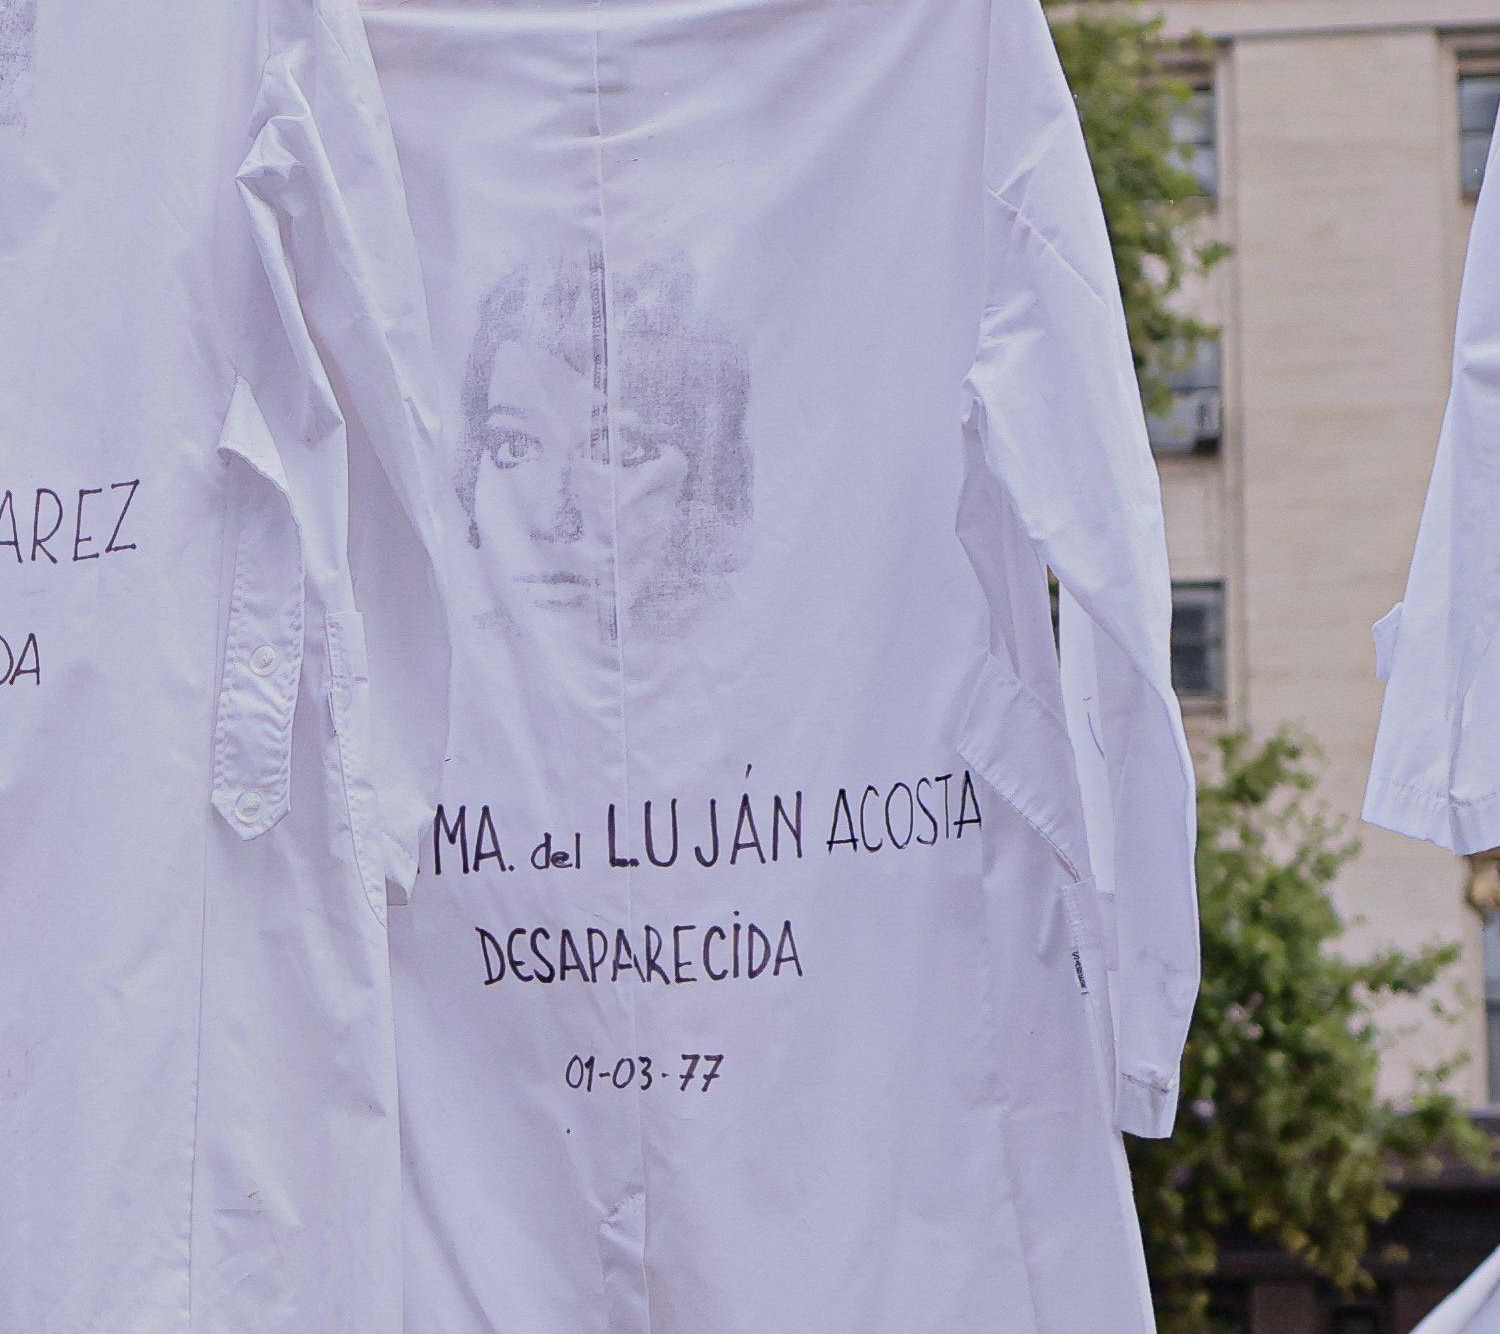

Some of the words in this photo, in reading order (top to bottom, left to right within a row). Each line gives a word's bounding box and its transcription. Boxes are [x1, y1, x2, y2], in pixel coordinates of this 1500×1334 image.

[529, 830, 582, 871] del
[606, 762, 804, 869] LUJÁN
[824, 768, 983, 855] ACOSTA
[473, 909, 804, 987] DESAPARECIDA
[564, 1052, 726, 1094] 01-03-77
